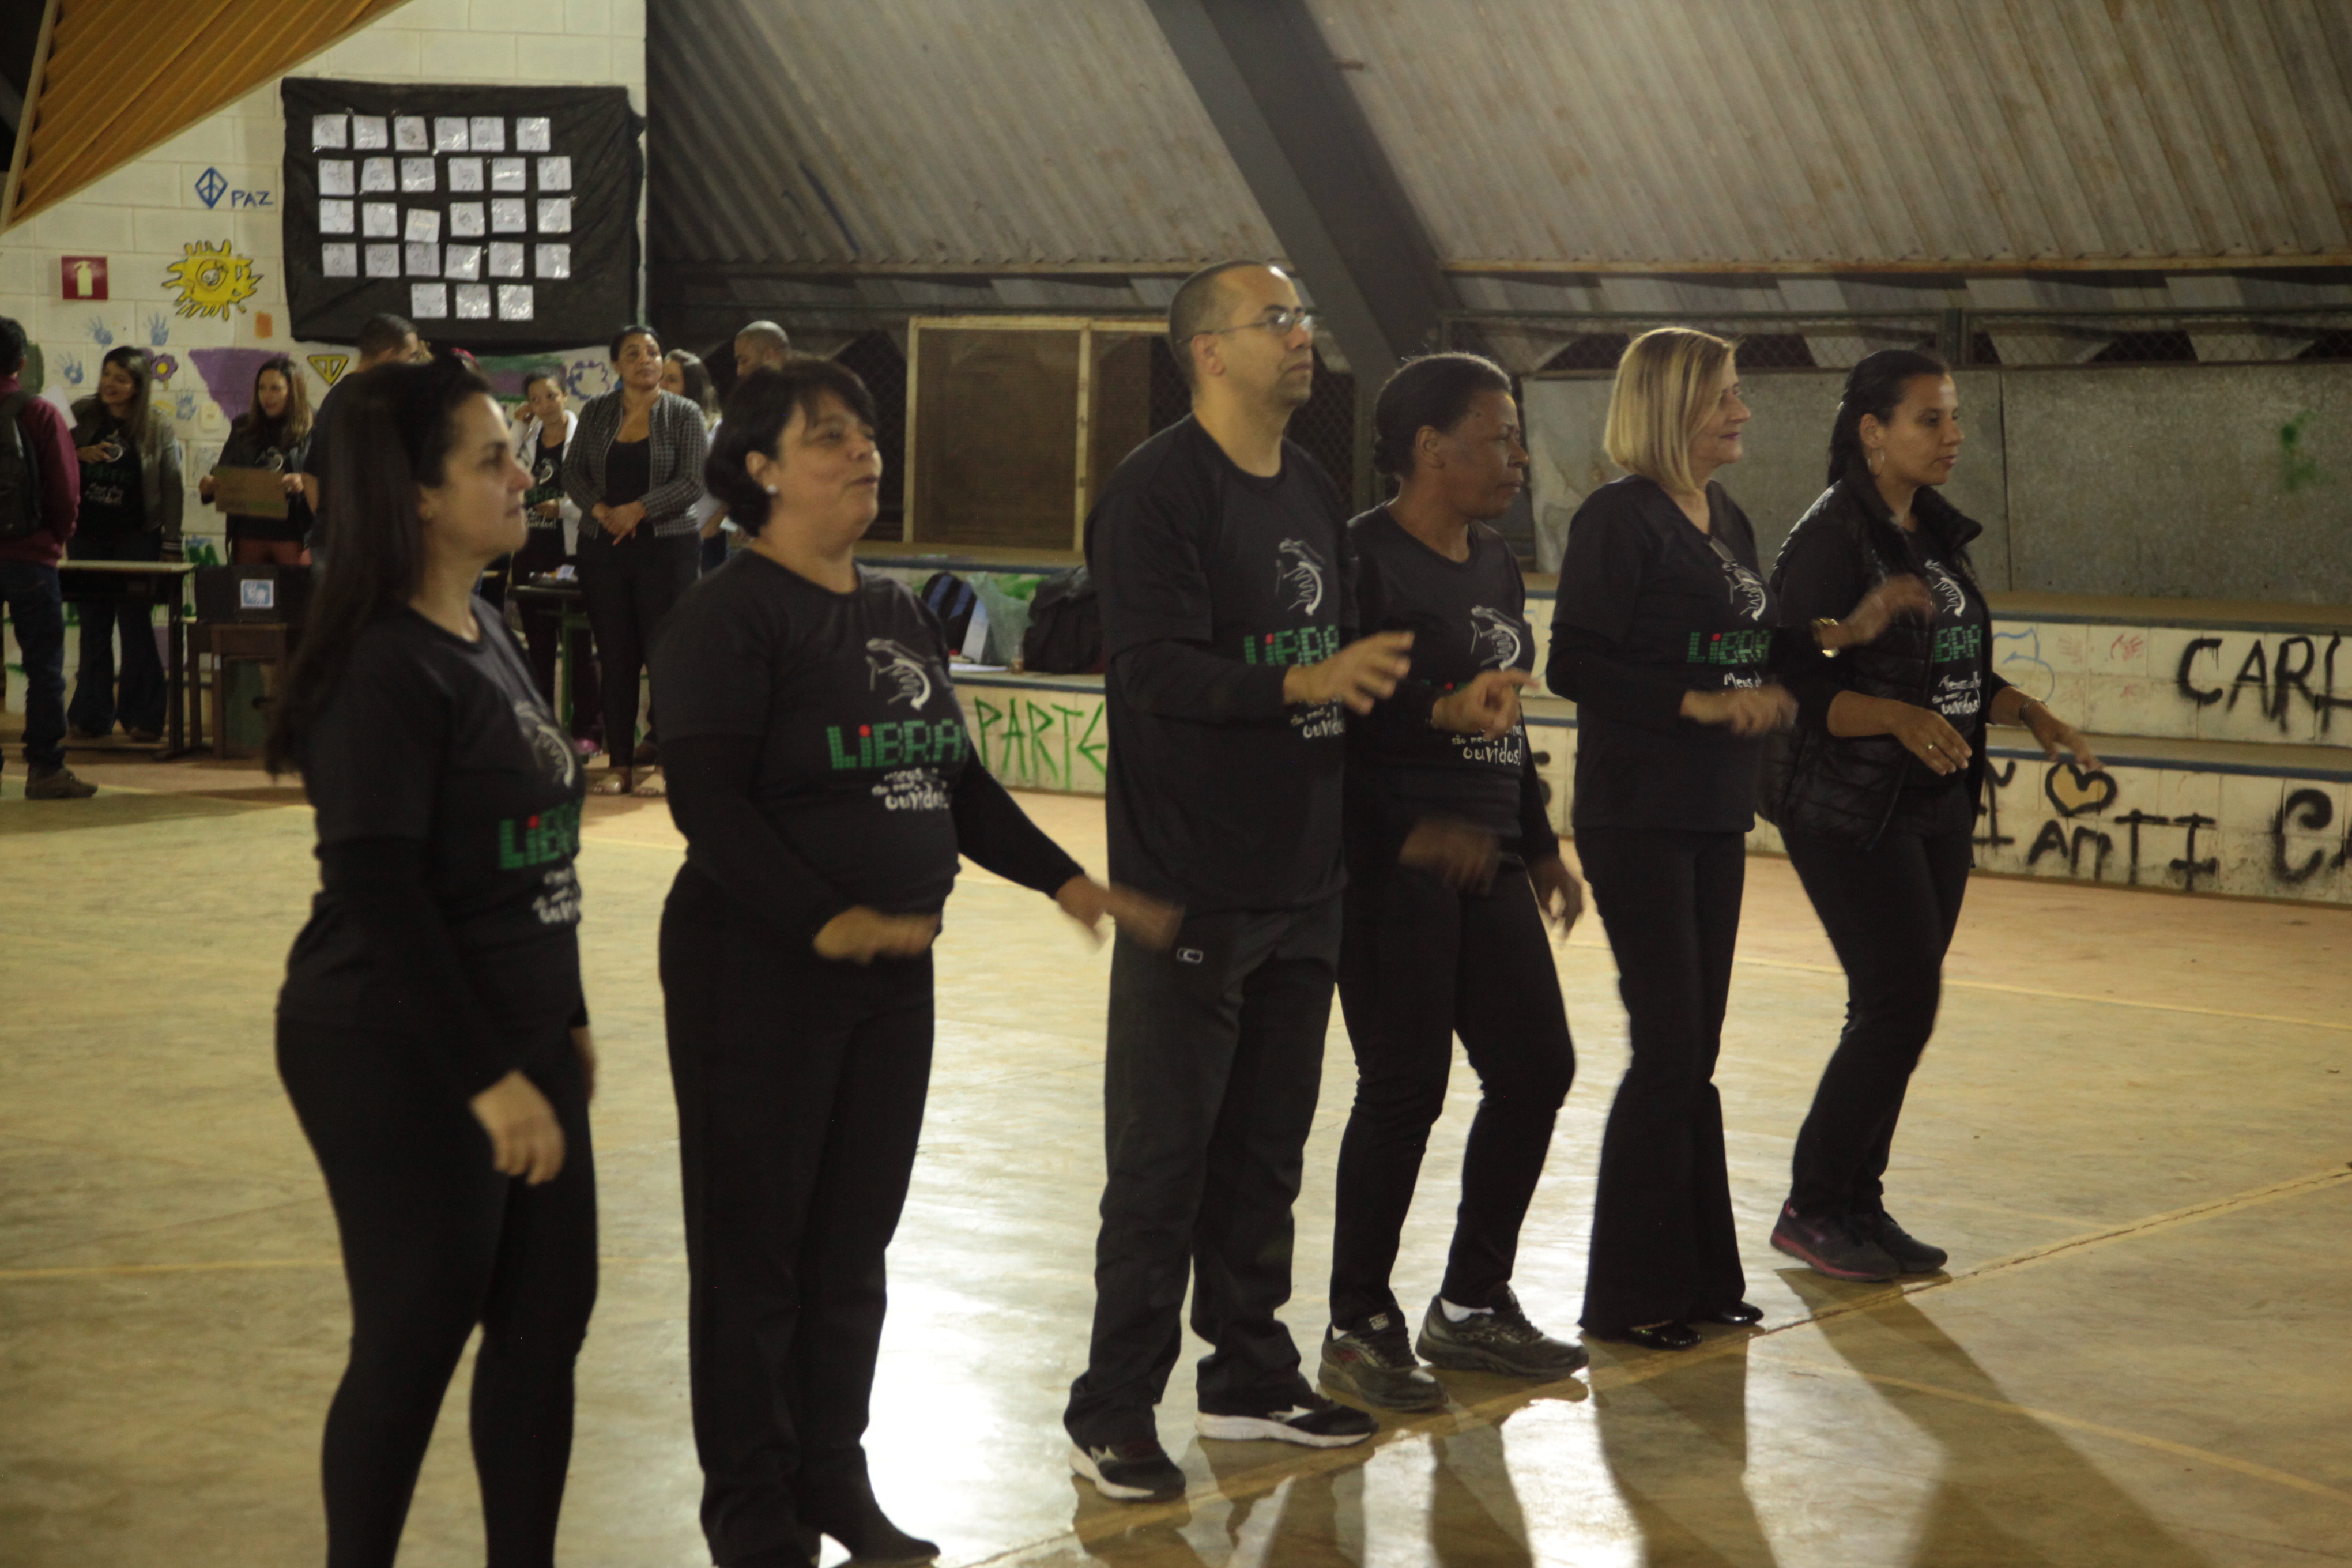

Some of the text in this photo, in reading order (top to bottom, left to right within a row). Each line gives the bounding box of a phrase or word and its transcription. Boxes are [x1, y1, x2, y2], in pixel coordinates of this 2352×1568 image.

[231, 189, 274, 208] PAZ
[826, 718, 970, 770] LiBRA
[1452, 734, 1467, 745] são
[1463, 737, 1522, 767] ouvidos!
